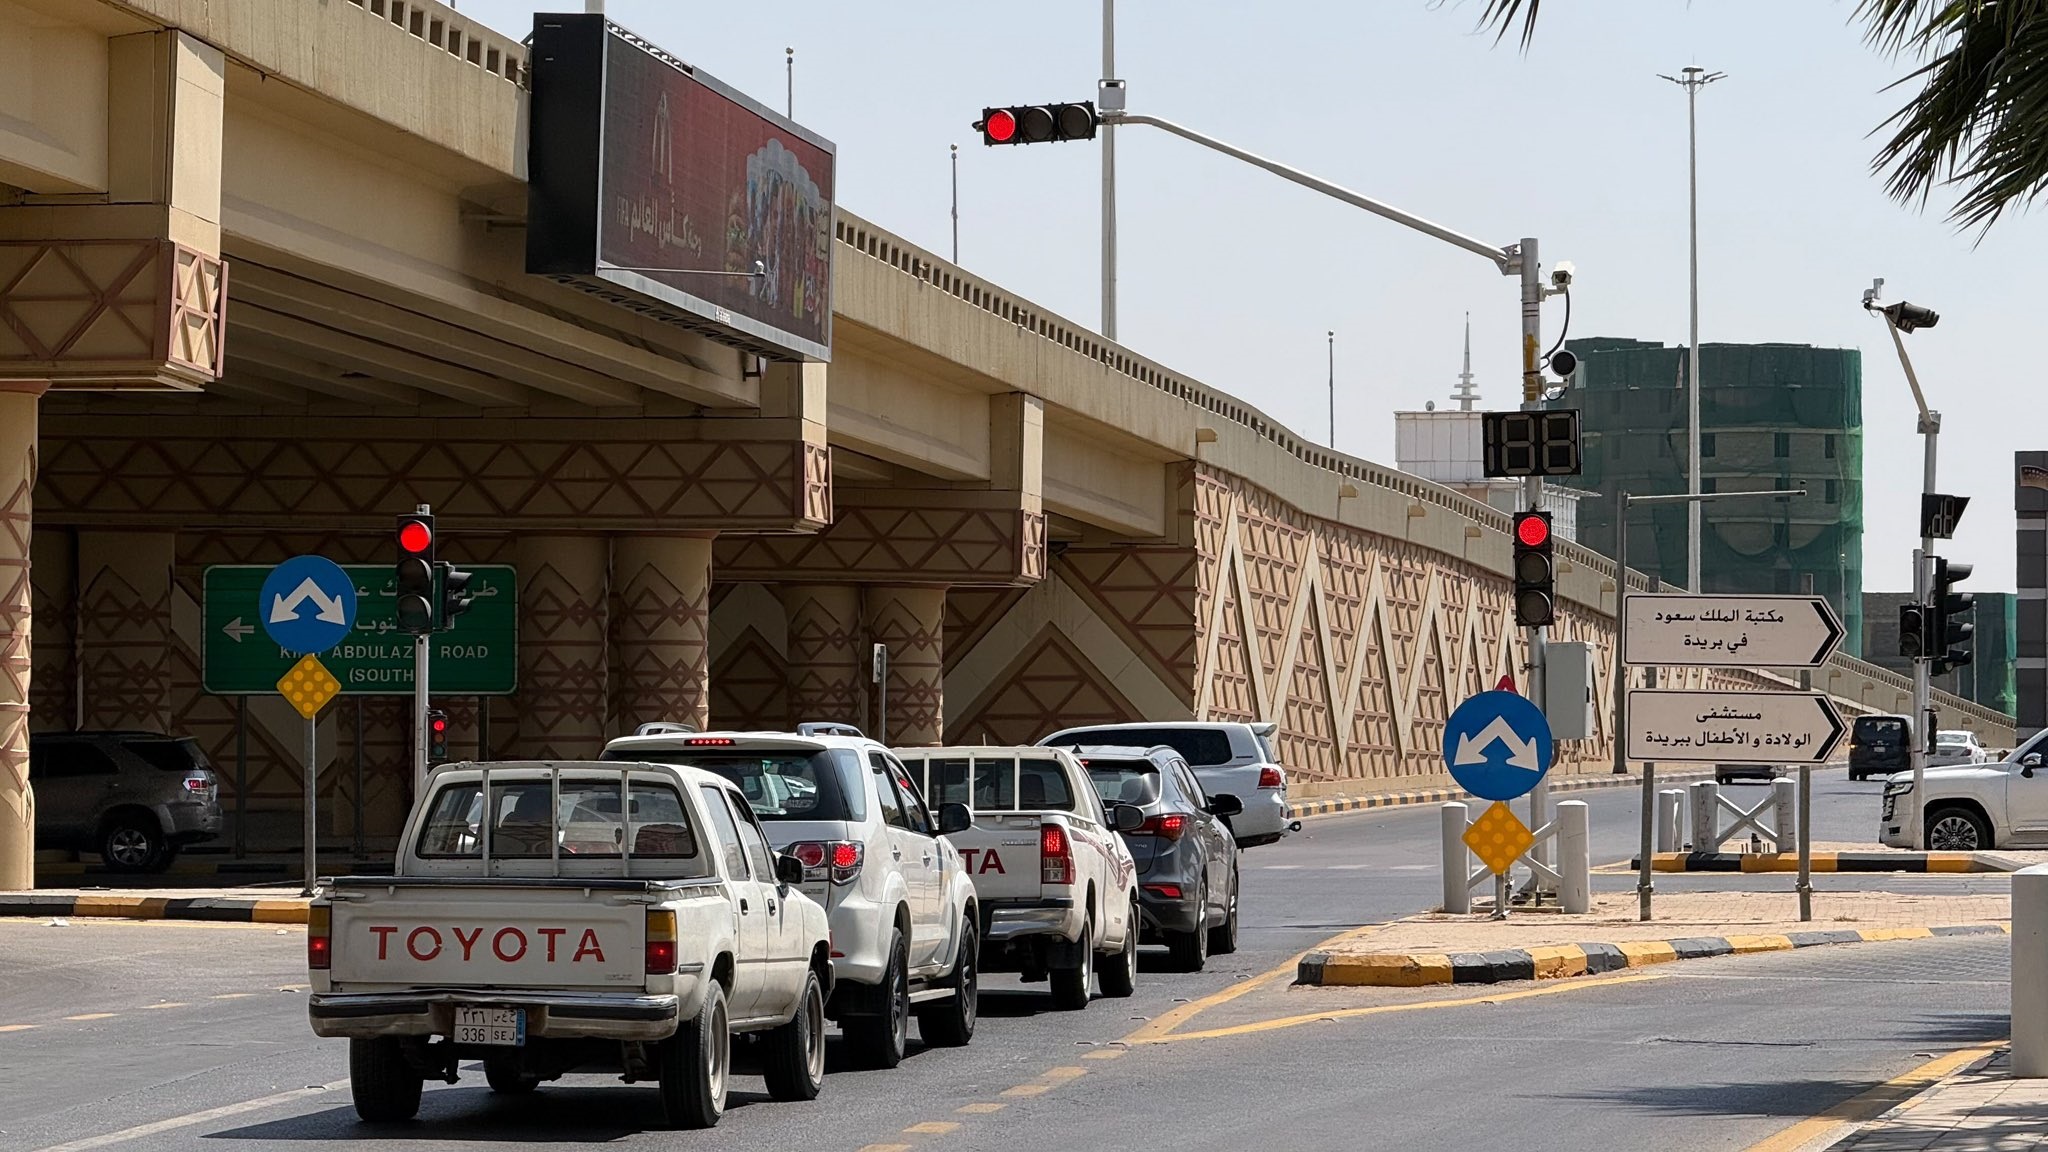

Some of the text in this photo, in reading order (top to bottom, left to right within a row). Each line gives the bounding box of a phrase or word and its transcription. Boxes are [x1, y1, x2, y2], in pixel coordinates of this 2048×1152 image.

[1655, 608, 1784, 625] مكتبة الملك سعود
[1684, 632, 1748, 654] في بريدة
[332, 645, 430, 659] ABDULAZ
[440, 645, 489, 659] ROAD
[349, 667, 414, 683] (SOUTH
[1696, 705, 1762, 723] مستشفى
[1645, 727, 1811, 748] الولادة و الأطفال ببريدة
[368, 925, 606, 964] TOYOTA
[461, 1027, 486, 1042] 336
